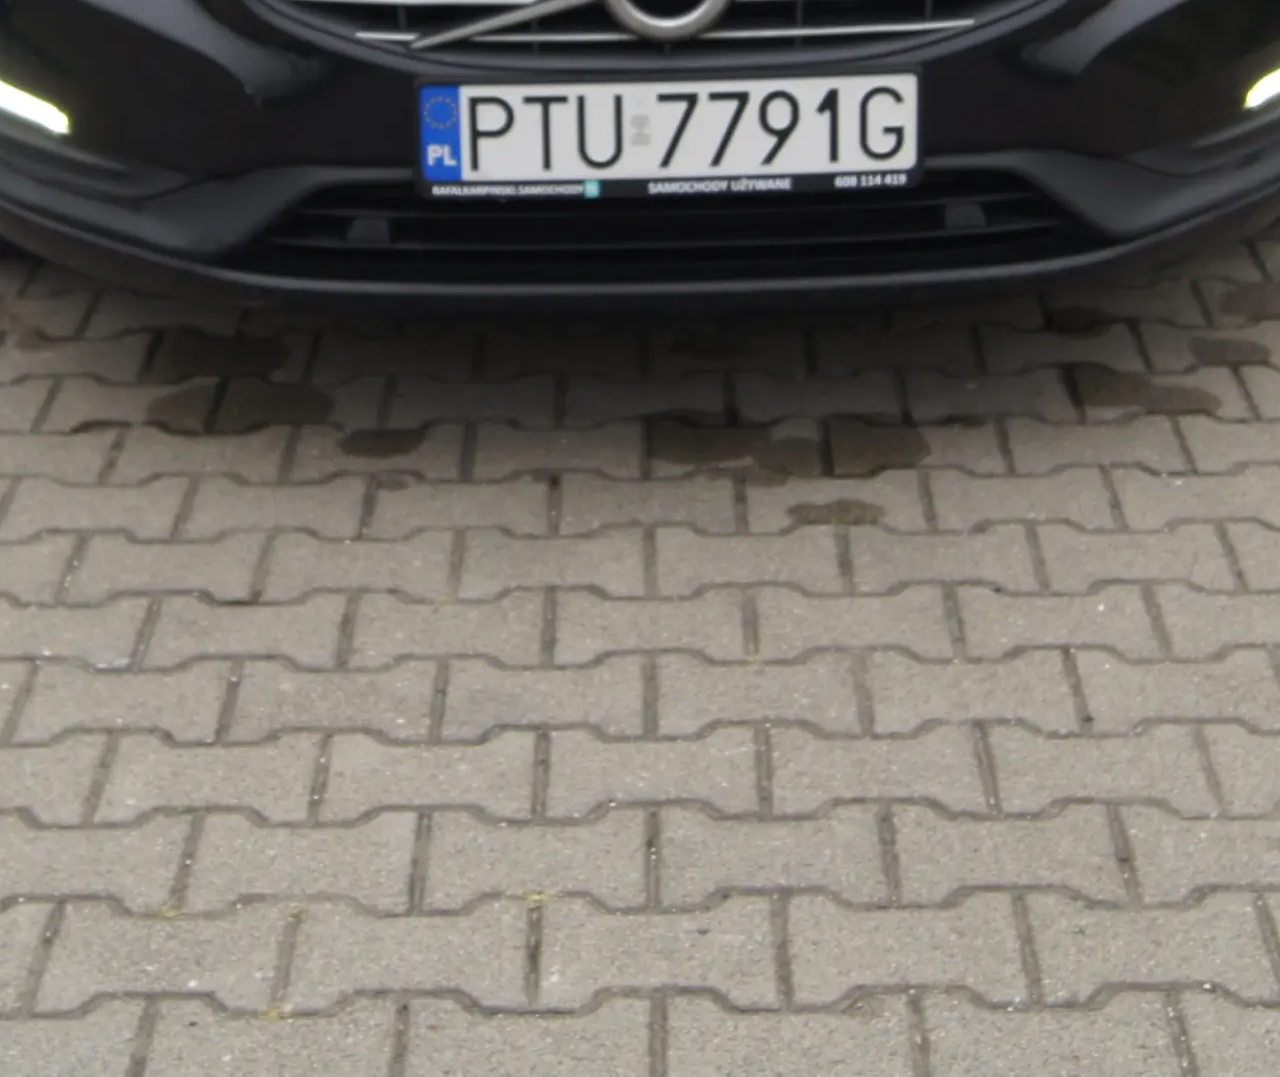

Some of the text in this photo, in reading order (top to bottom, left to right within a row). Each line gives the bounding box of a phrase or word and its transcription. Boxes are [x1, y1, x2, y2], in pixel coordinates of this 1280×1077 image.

[467, 86, 905, 172] PTU 7791G
[427, 144, 457, 166] PL
[647, 180, 728, 194] SAMOCHODY
